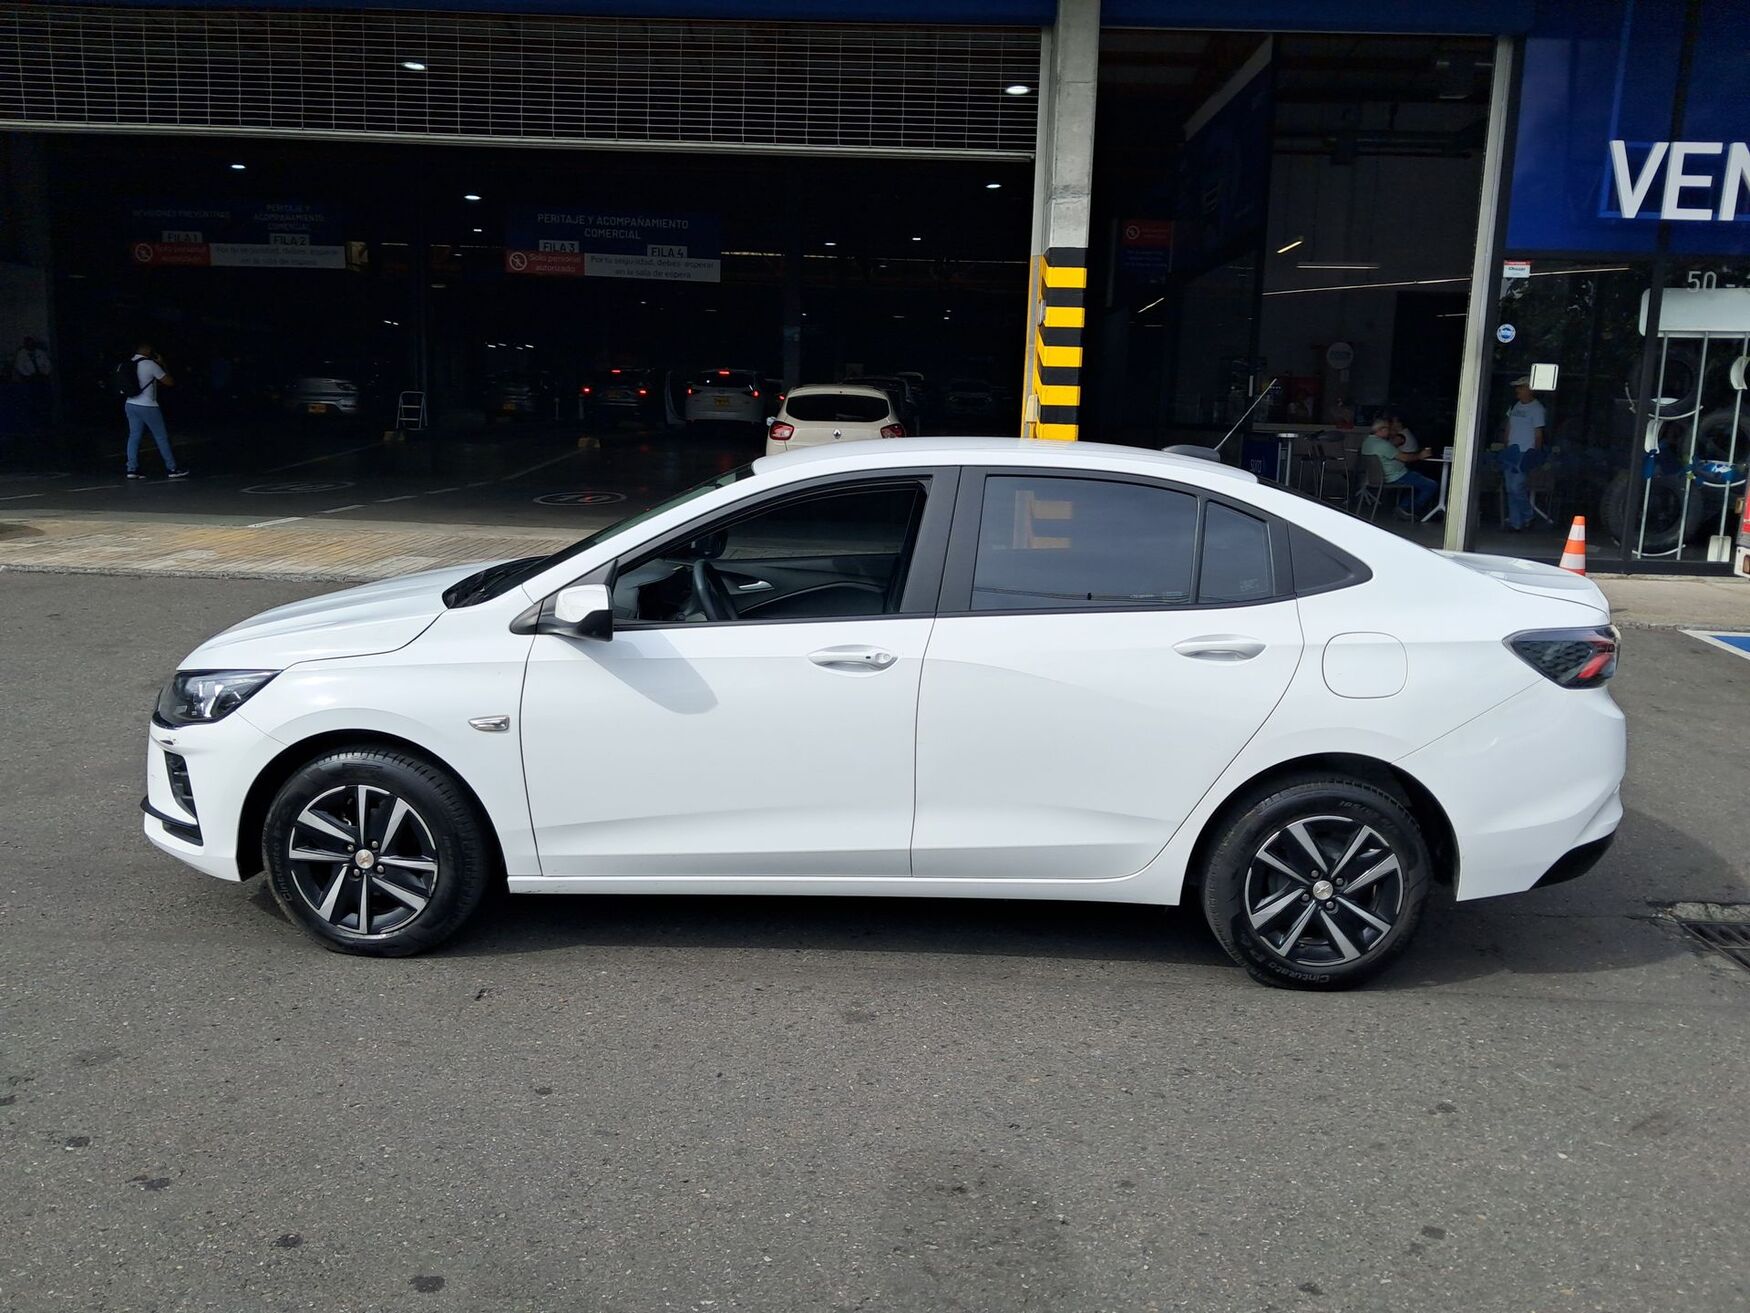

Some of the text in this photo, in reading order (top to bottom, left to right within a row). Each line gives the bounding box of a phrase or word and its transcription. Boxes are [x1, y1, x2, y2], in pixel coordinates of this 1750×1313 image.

[537, 213, 689, 230] PERITAJE Y ACOMPAÑAMIENTO
[167, 232, 191, 241] FILA
[584, 227, 641, 240] COMERCIAL
[273, 235, 307, 246] FILA 2
[543, 242, 576, 253] FILA 3
[651, 247, 684, 258] FILA 4
[1688, 270, 1717, 293] 50
